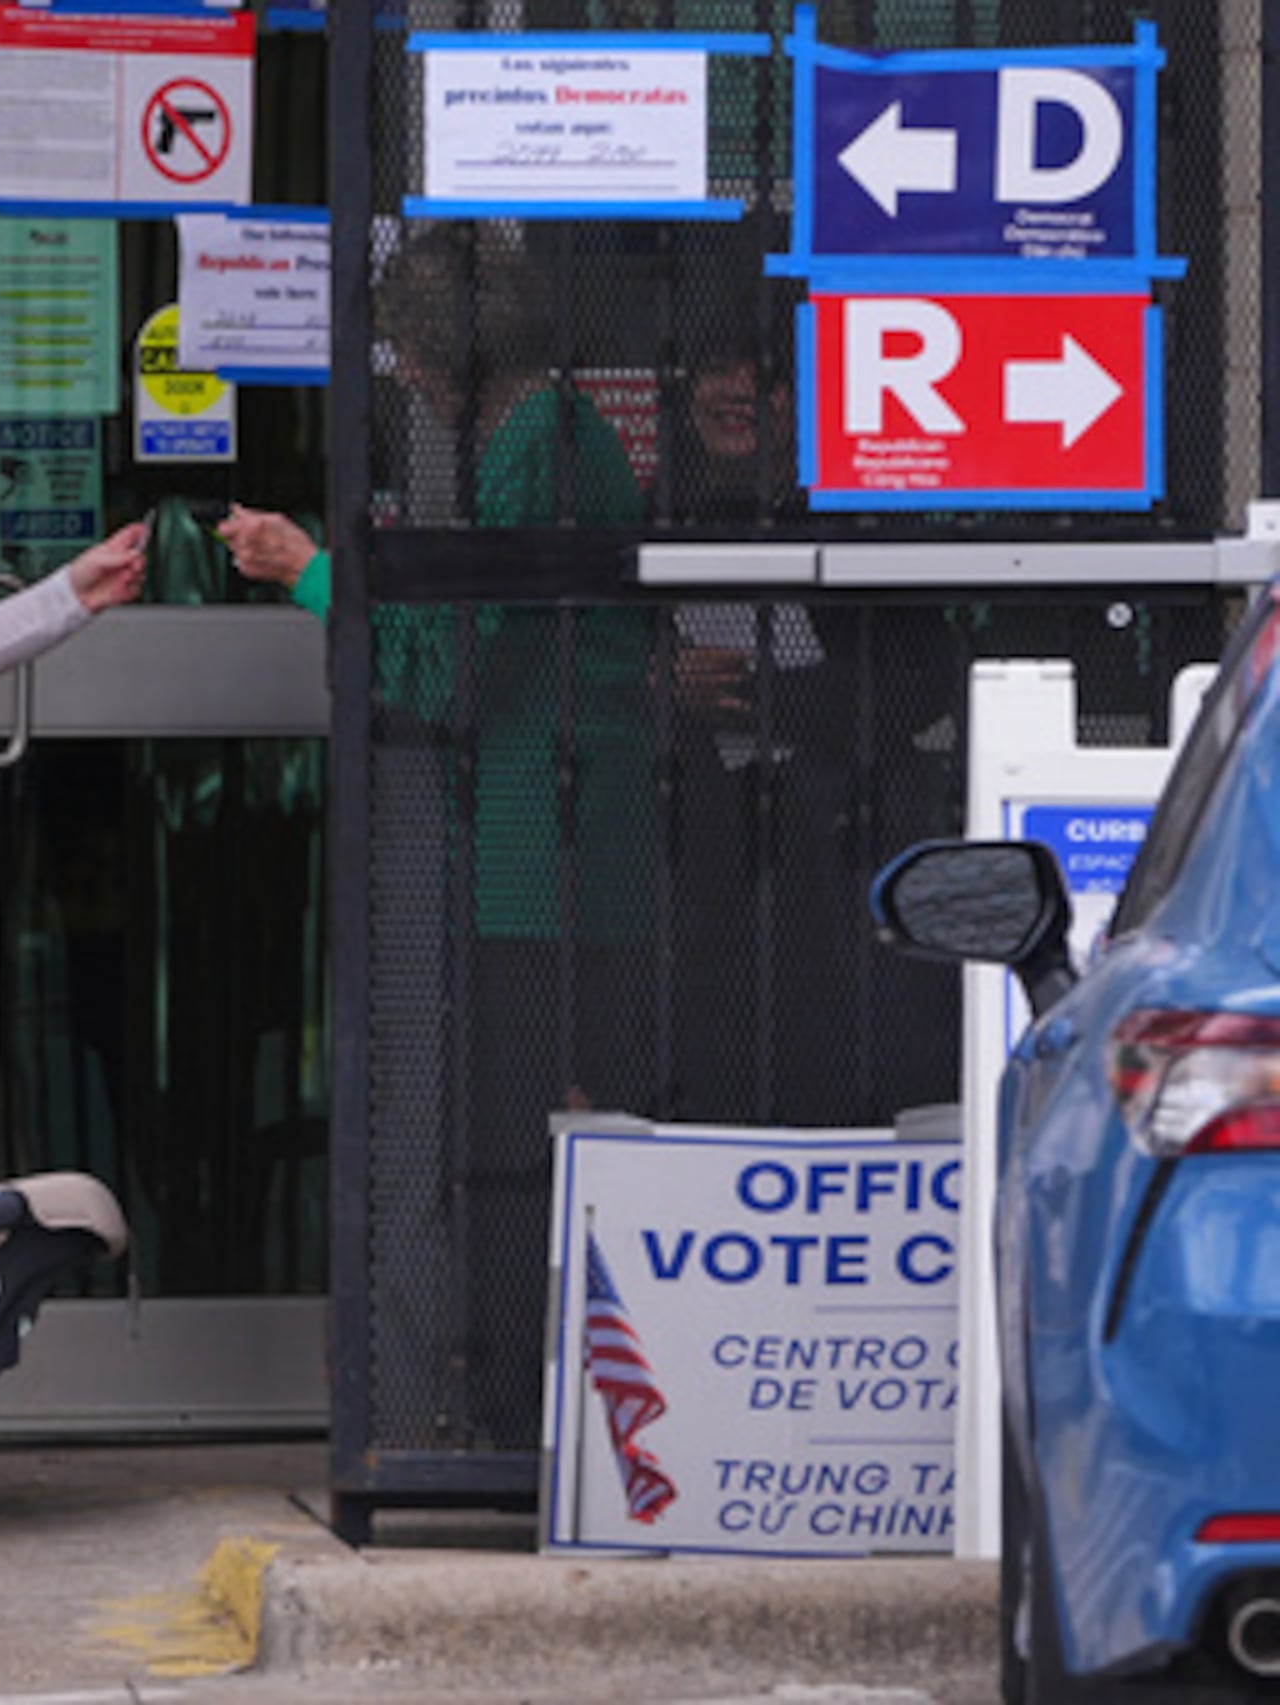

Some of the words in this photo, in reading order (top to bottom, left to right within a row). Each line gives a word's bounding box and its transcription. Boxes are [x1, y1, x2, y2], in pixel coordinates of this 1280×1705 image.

[540, 54, 630, 75] siguientes
[995, 67, 1124, 204] D
[1014, 208, 1093, 226] Democrat
[199, 252, 291, 275] Republican
[844, 298, 966, 434] R
[164, 380, 205, 395] DOOR
[2, 424, 90, 446] NOTICE
[858, 438, 945, 454] Republican
[641, 1230, 870, 1284] VOTE
[713, 1335, 928, 1370] CENTRO
[748, 1379, 816, 1410] DE
[714, 1459, 890, 1495] TRUNG
